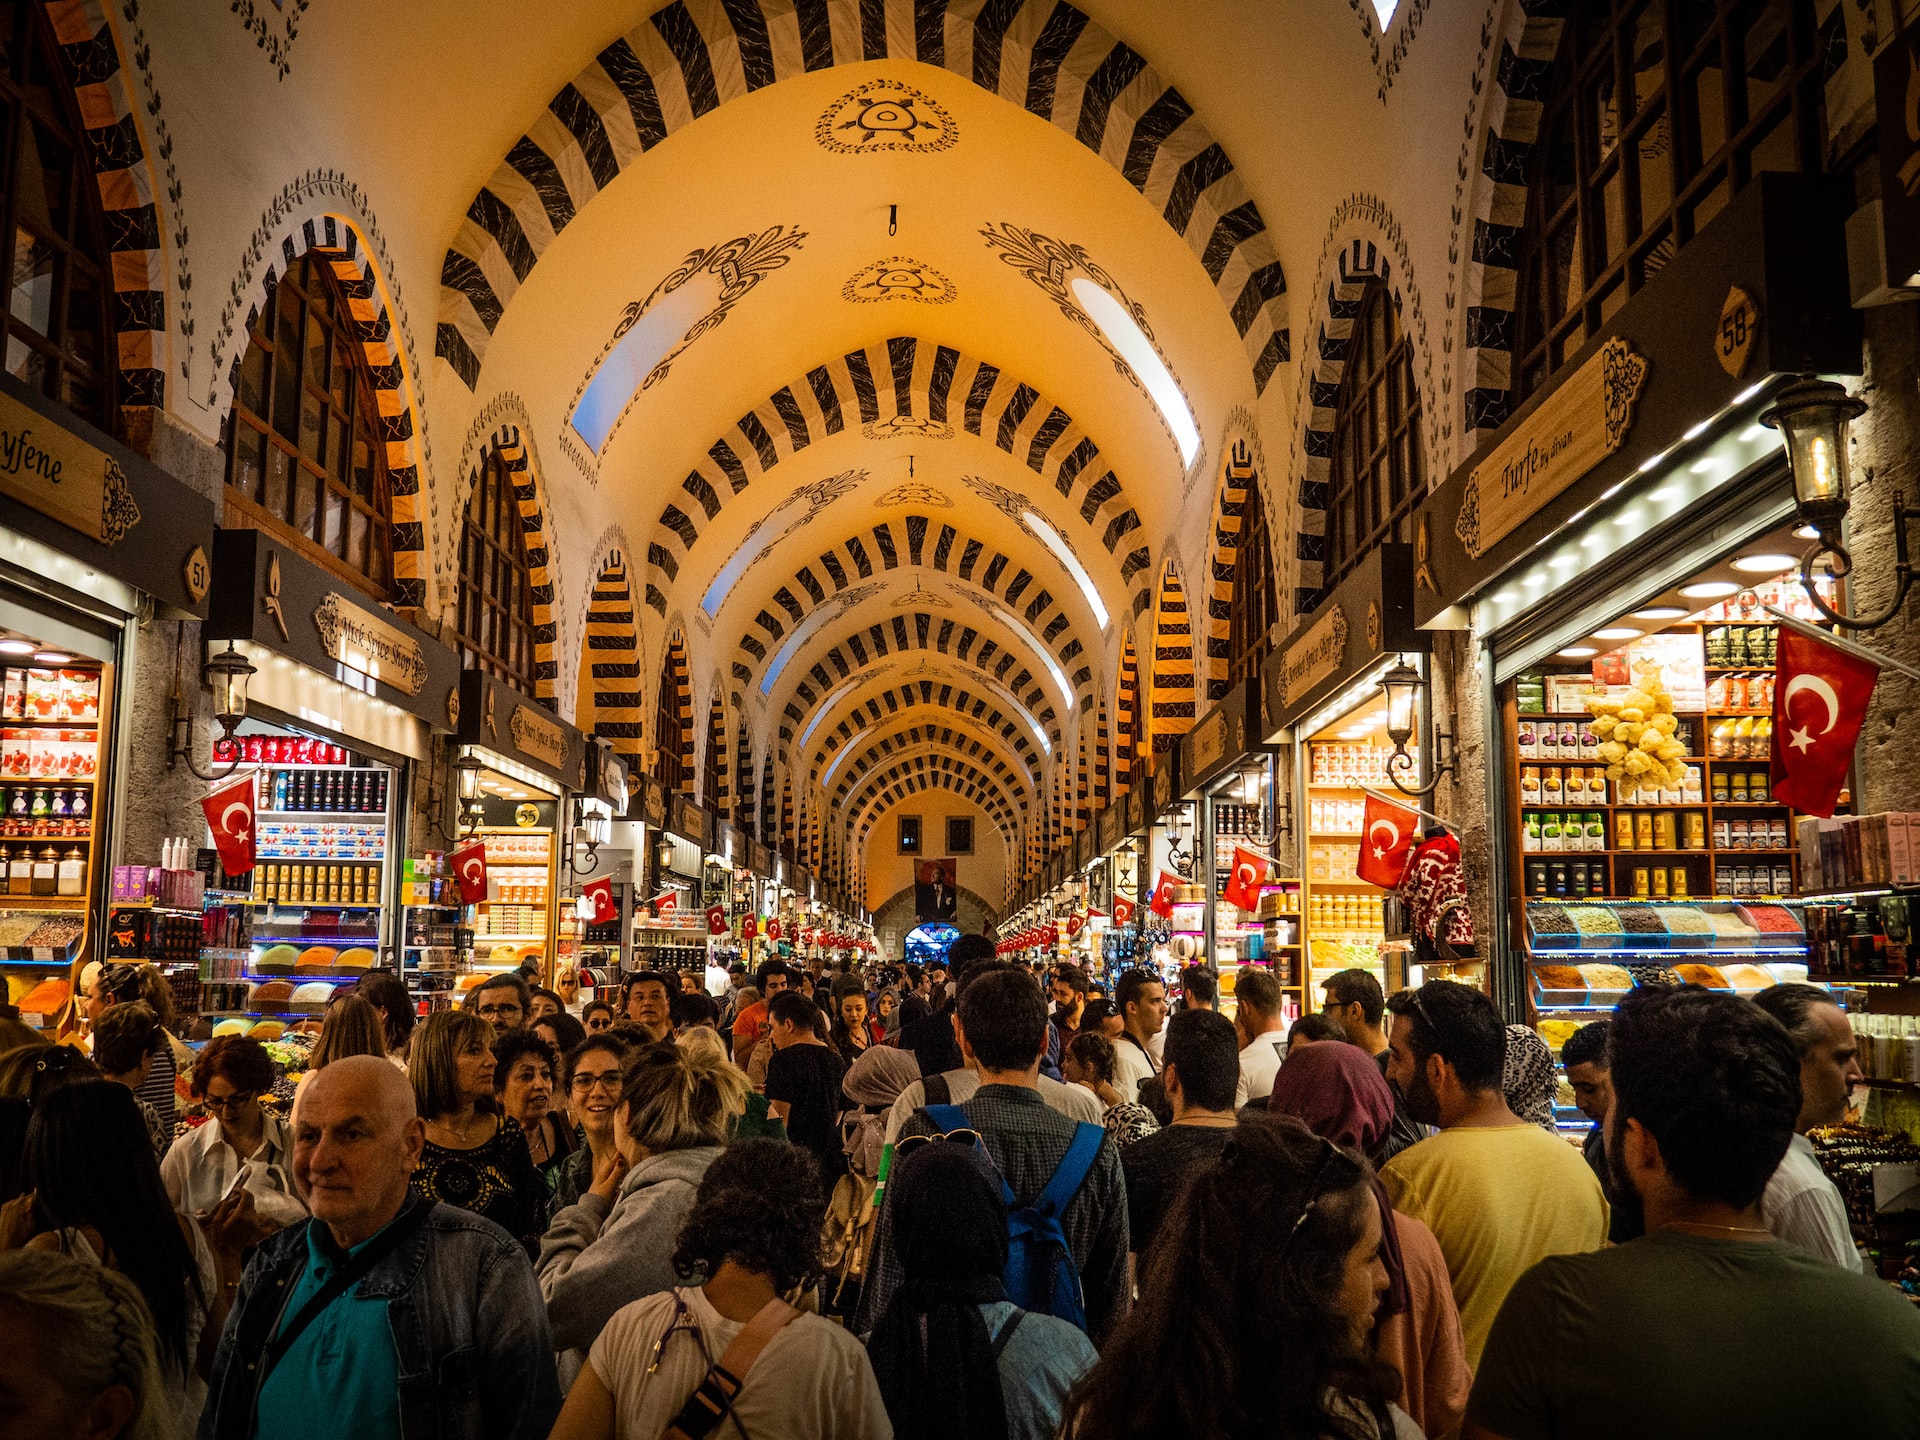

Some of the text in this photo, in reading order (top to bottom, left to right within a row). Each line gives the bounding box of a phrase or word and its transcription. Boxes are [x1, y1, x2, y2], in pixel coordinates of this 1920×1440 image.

[1722, 306, 1746, 356] 58
[0, 429, 62, 484] yfene
[1501, 437, 1538, 499] Turfe
[192, 562, 206, 590] 51
[340, 616, 411, 678] Misk Spice Shop
[519, 809, 536, 824] 55
[118, 914, 134, 924] Q7
